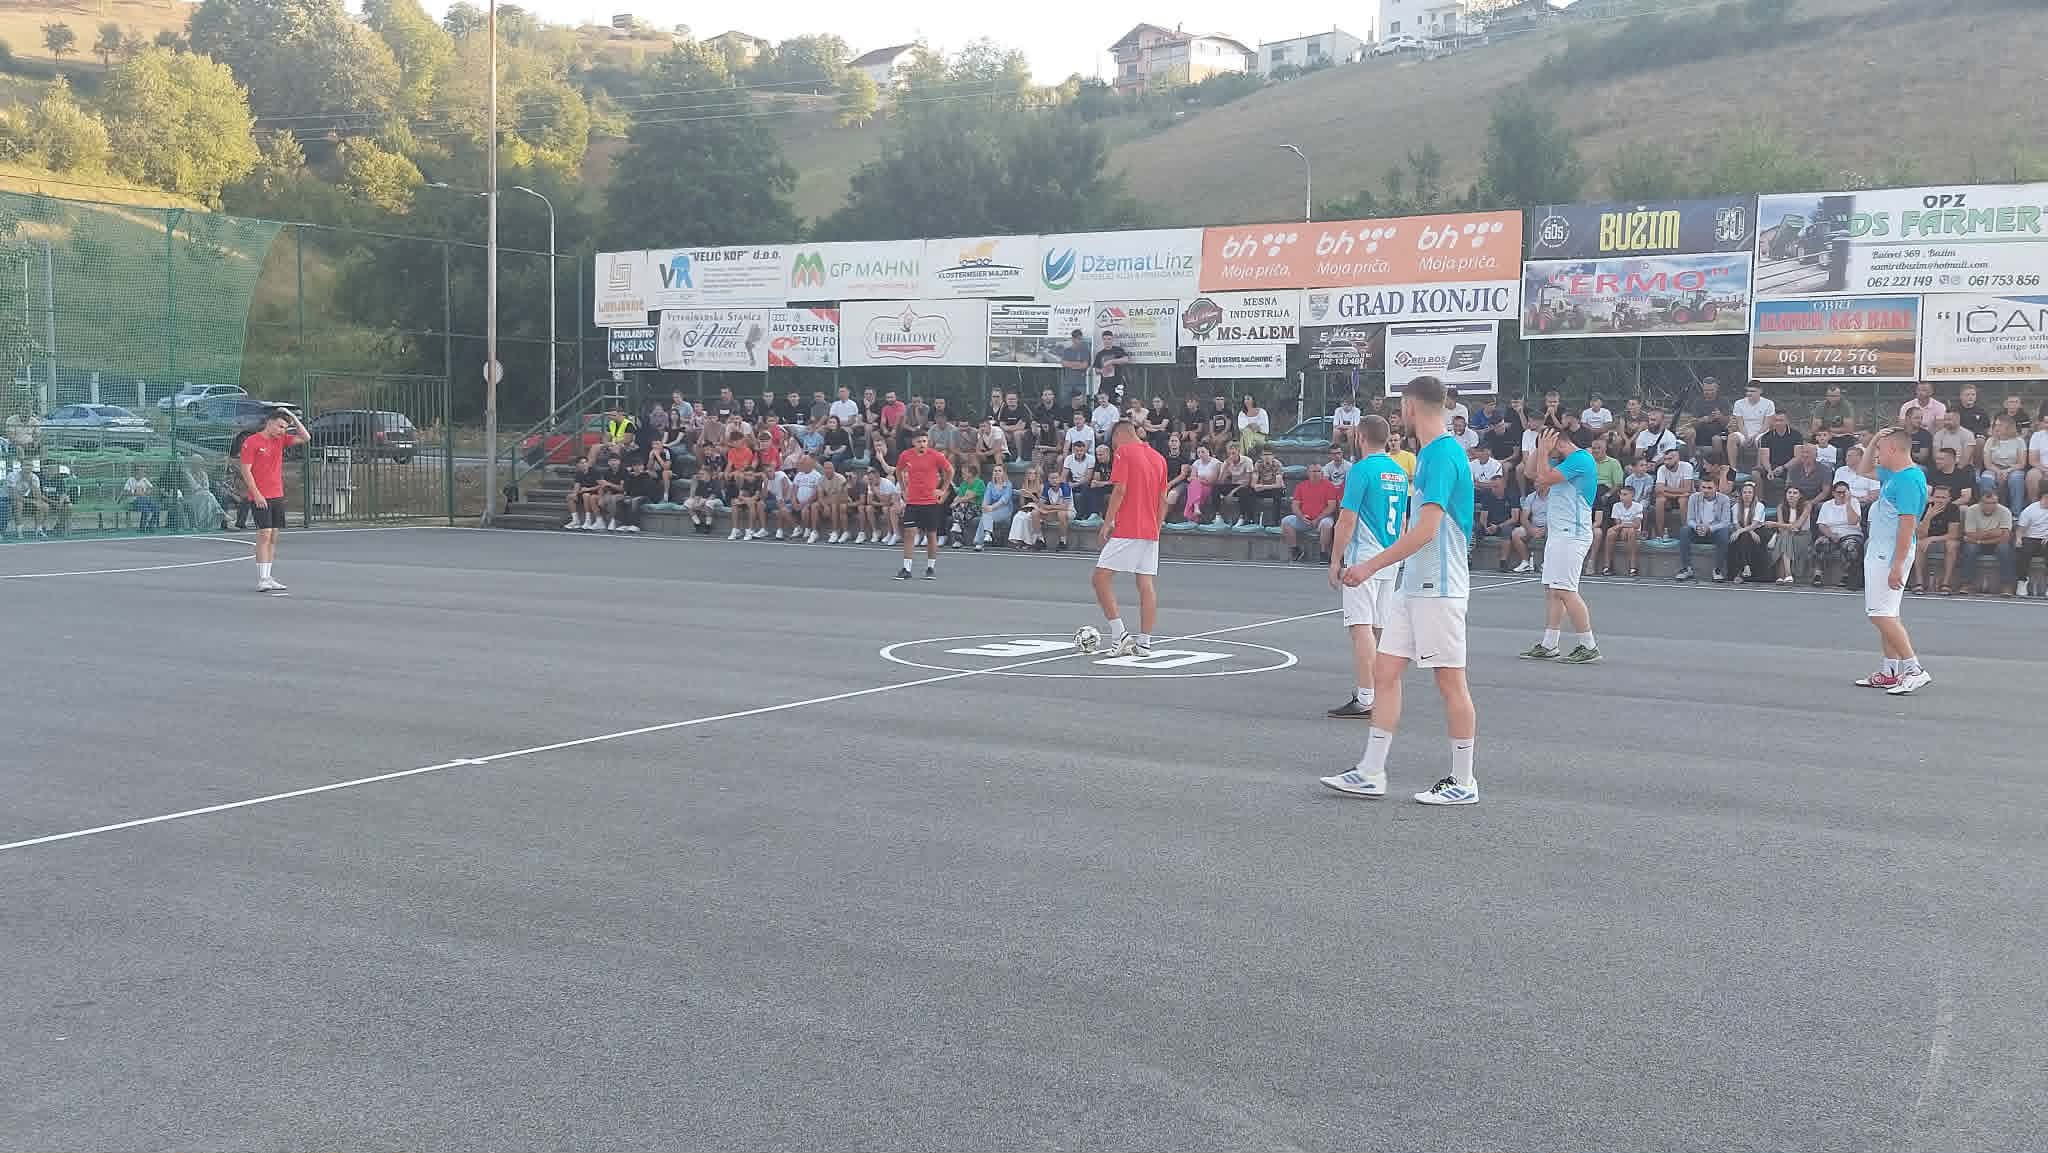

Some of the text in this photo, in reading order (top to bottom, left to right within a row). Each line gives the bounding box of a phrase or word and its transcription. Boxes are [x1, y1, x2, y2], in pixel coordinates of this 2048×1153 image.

[1923, 194, 1966, 208] OPZ
[1867, 275, 1933, 288] 062 221 149
[1968, 274, 2040, 286] 061 753 856
[1243, 297, 1278, 306] MESNA
[1339, 287, 1510, 318] GRAD KONJIC
[1230, 309, 1290, 319] INDUSTRIJA
[772, 324, 835, 332] AUTOSERVIS
[1217, 325, 1296, 341] MS-ALEM
[1778, 349, 1878, 363] 061 772 576
[1787, 364, 1877, 375] Lubarda 184
[1386, 495, 1399, 536] 5
